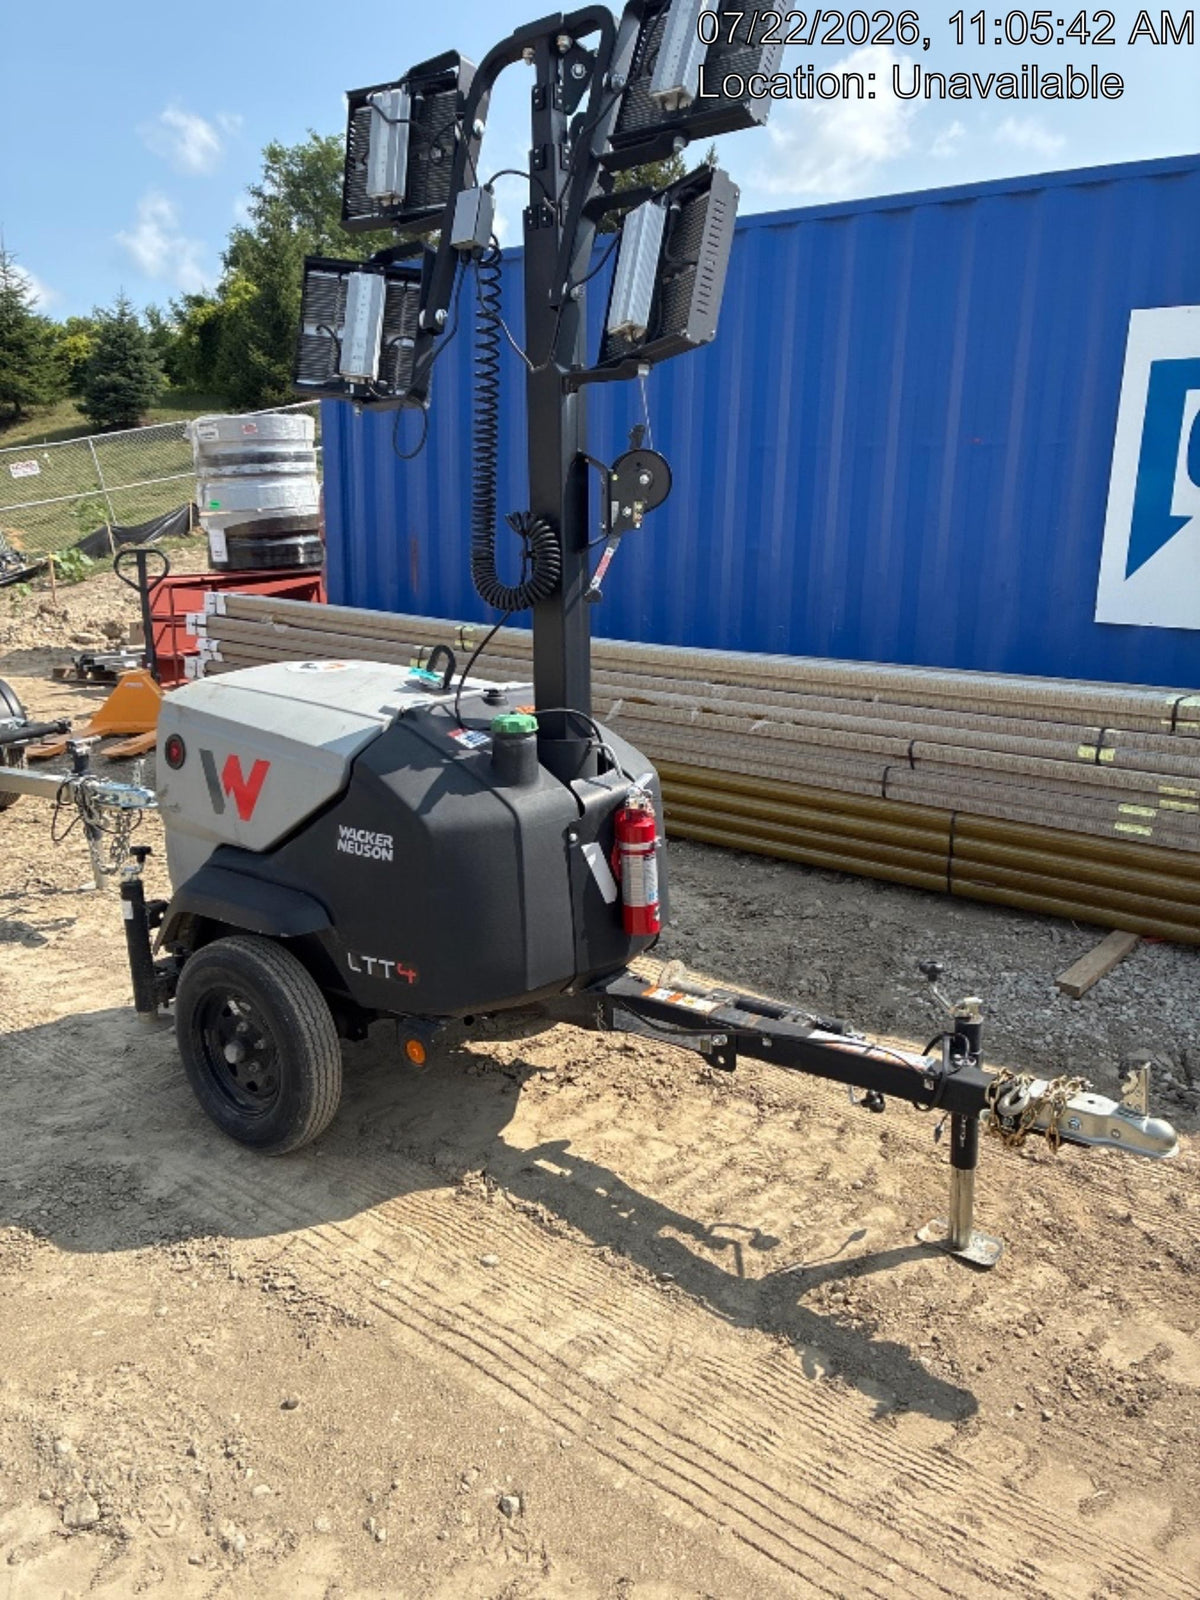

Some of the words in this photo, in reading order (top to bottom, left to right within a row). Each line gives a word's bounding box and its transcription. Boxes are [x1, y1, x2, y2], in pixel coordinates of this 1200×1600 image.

[338, 824, 394, 849] WACKER
[337, 838, 394, 862] NEUSON
[347, 952, 417, 984] LTT4
